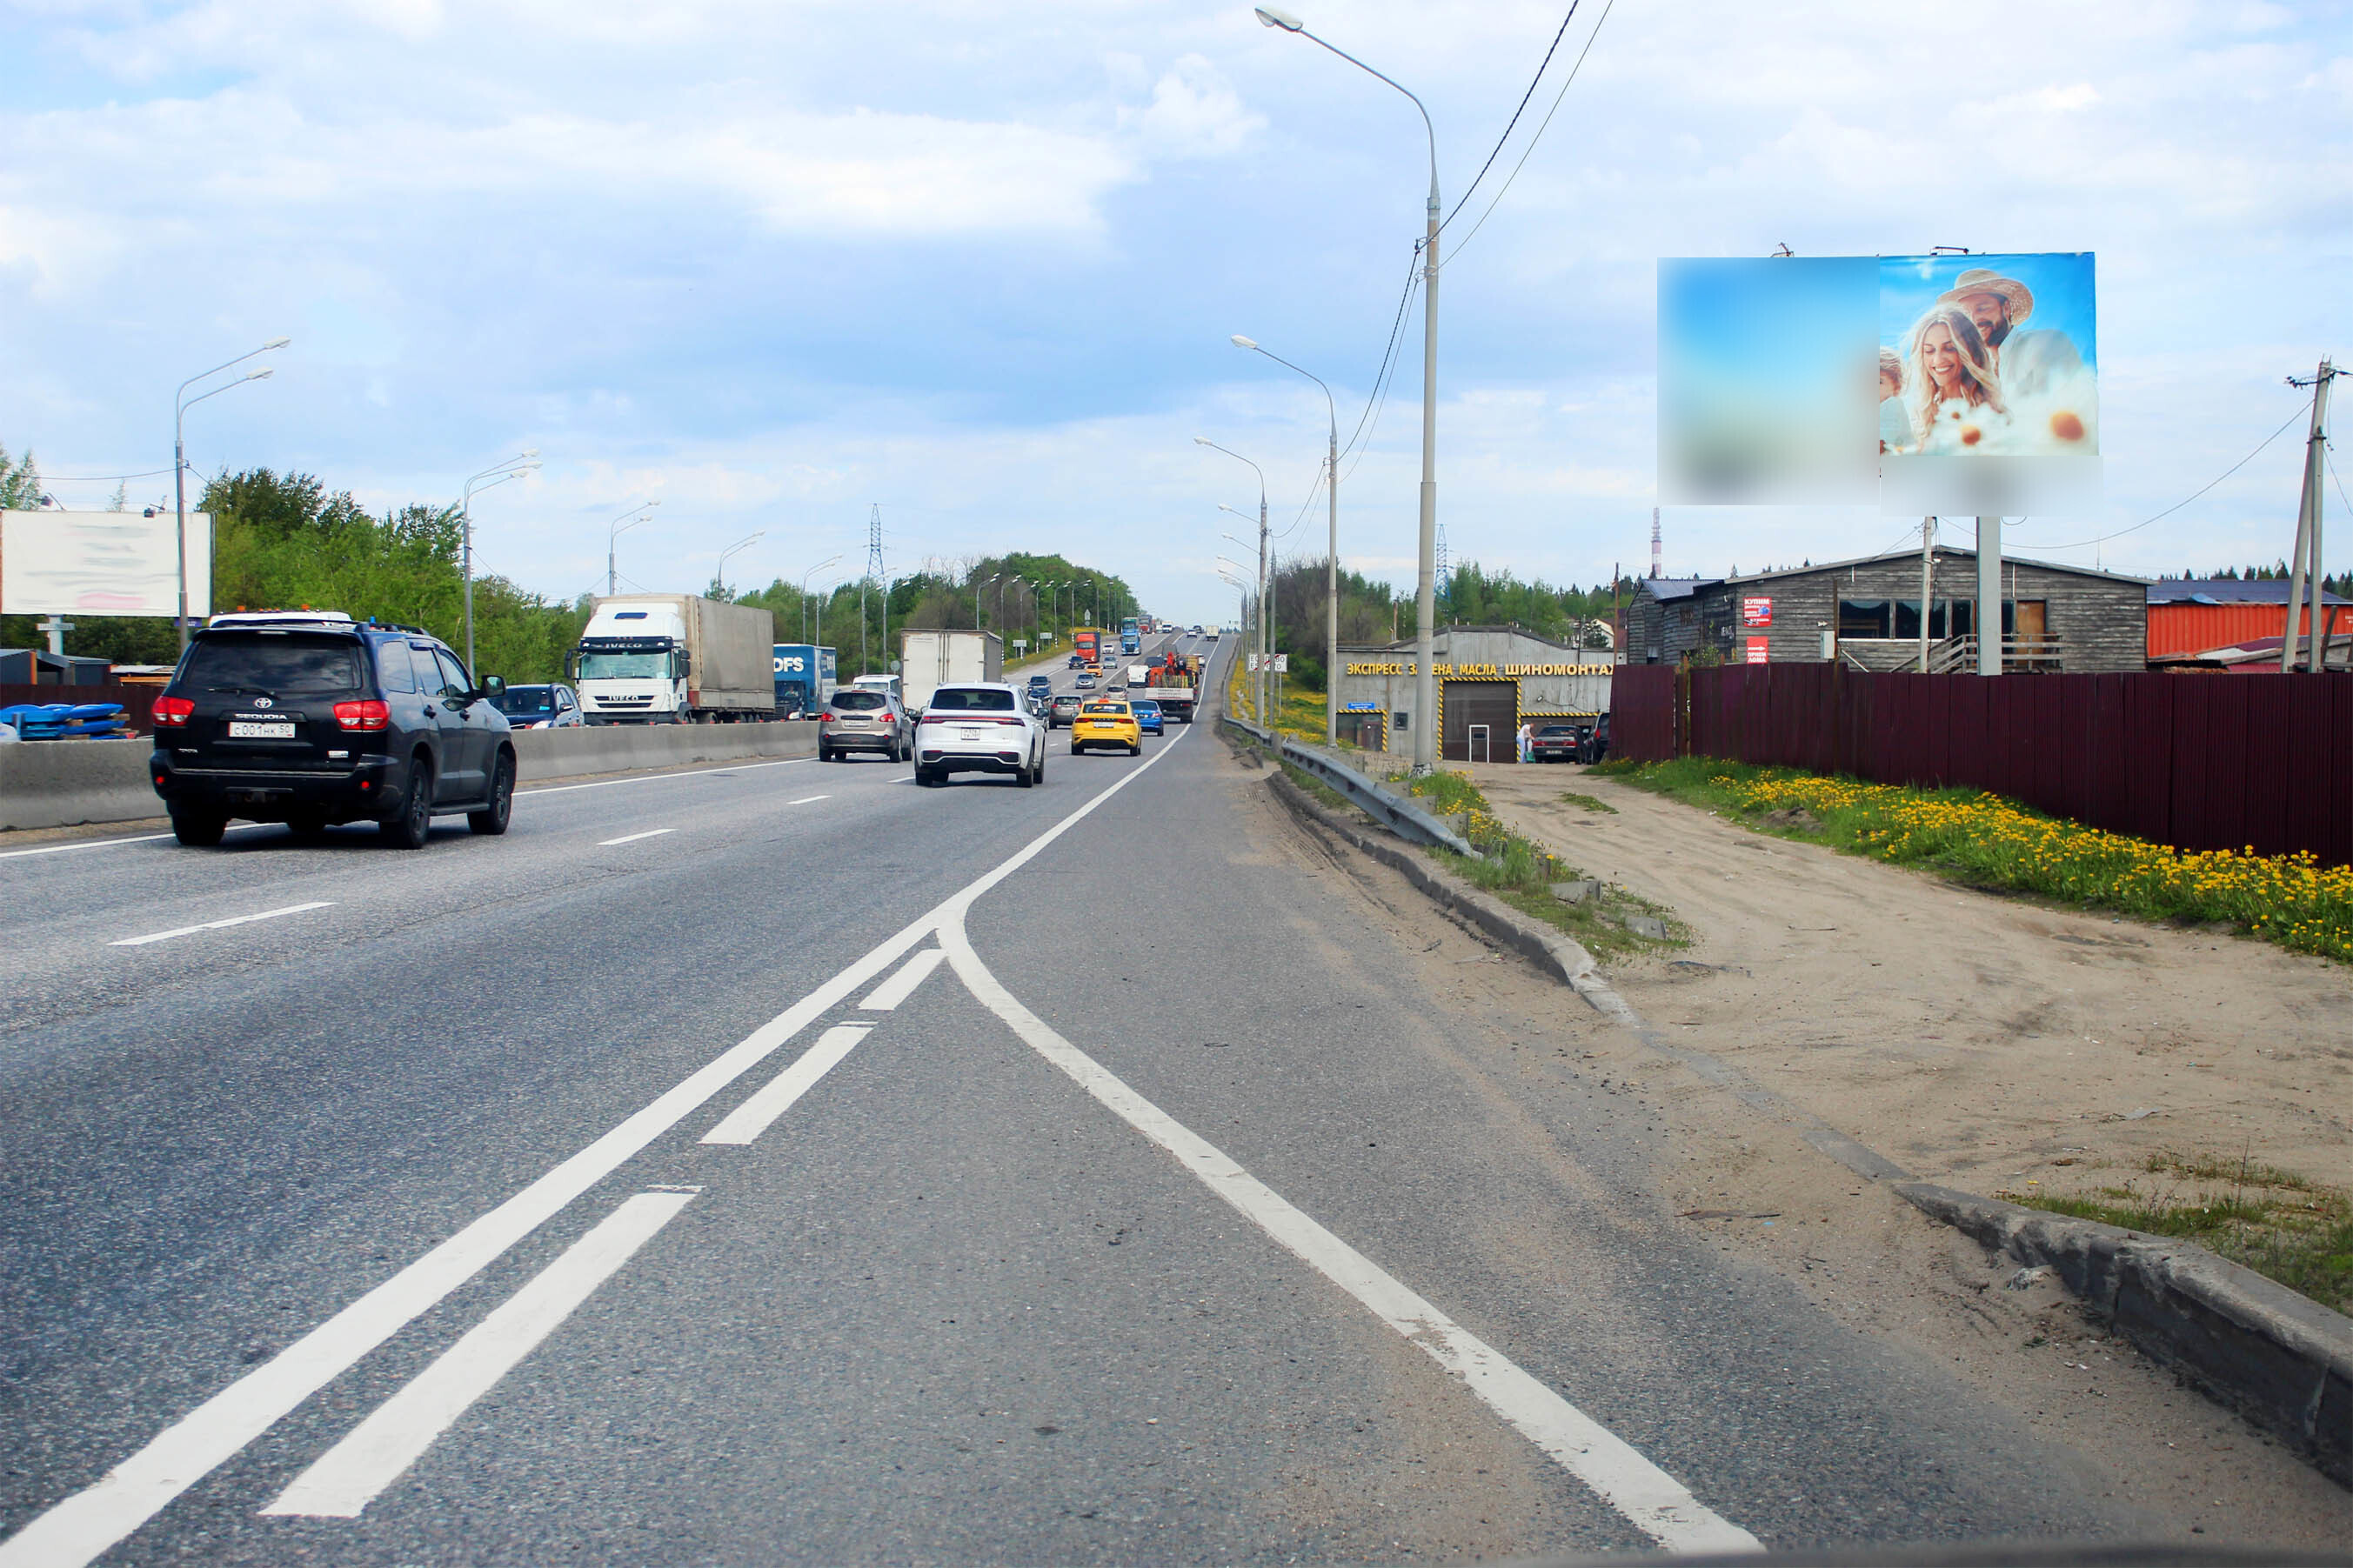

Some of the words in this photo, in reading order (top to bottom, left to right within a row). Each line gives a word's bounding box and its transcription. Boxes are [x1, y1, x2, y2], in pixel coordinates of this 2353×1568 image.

[1347, 664, 1403, 675] ЭКСПРЕСС
[1408, 664, 1454, 675] ЗЕНА
[1459, 664, 1497, 676] МАСЛА
